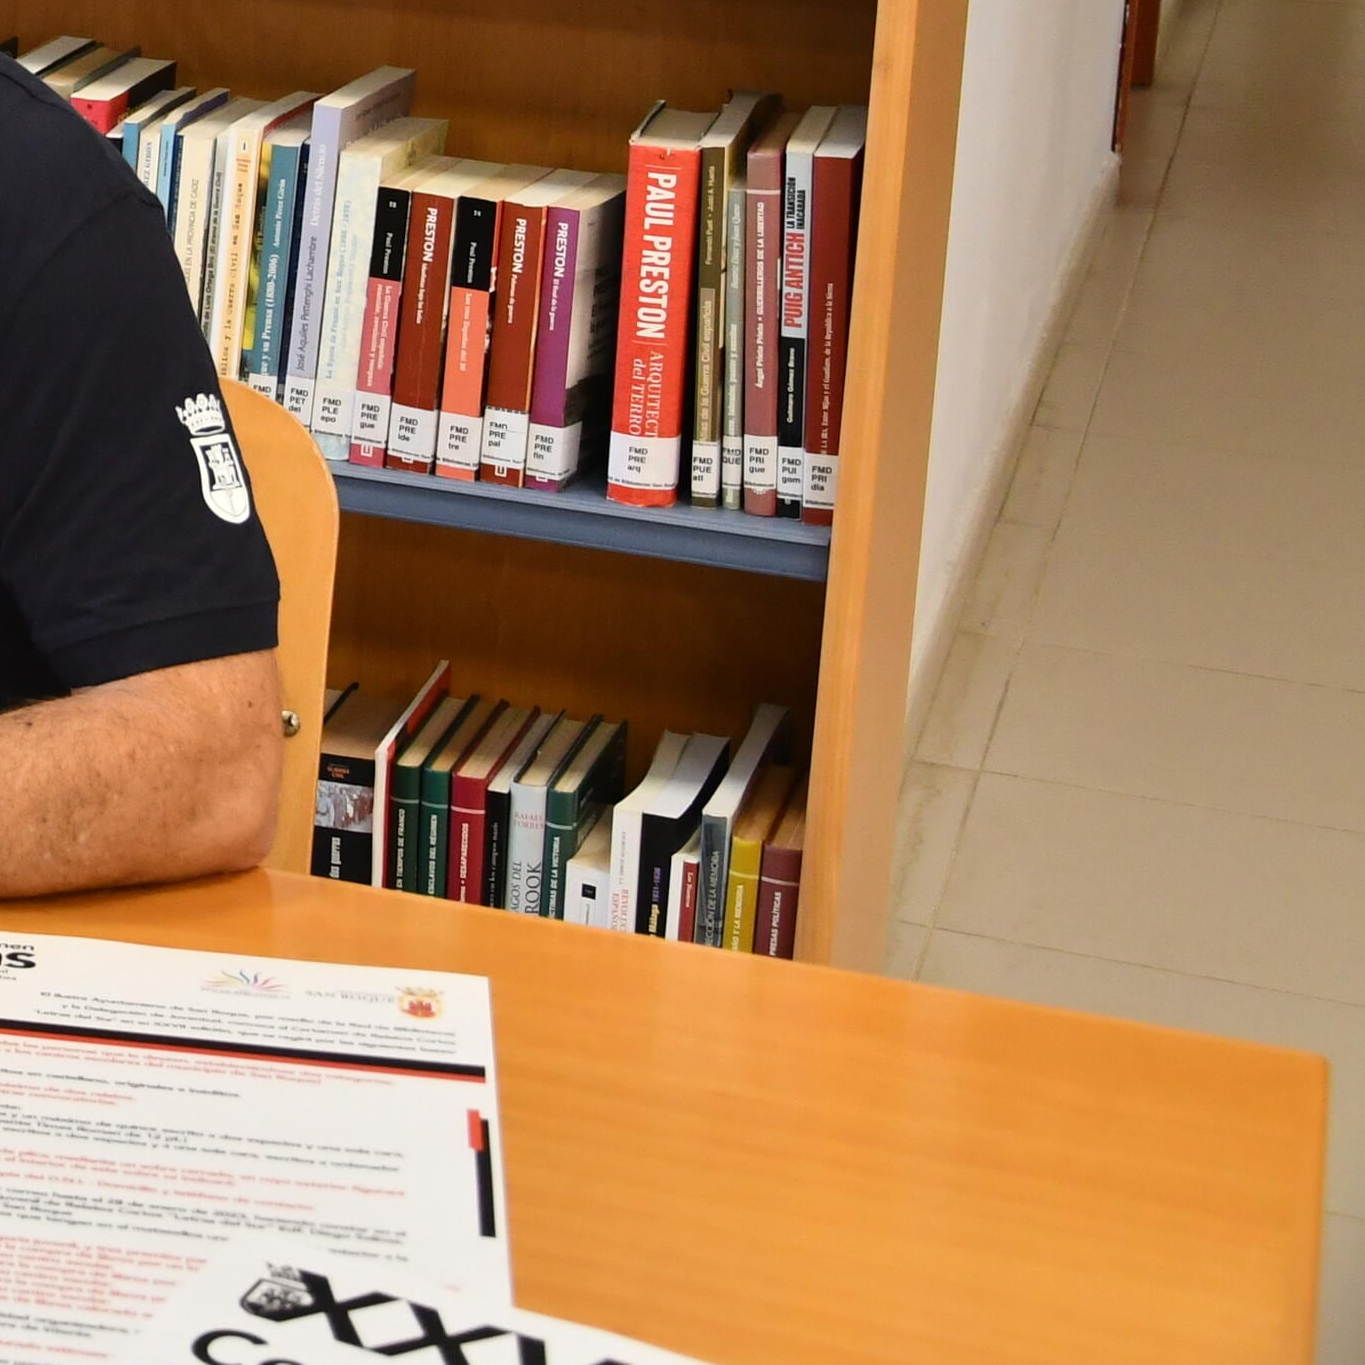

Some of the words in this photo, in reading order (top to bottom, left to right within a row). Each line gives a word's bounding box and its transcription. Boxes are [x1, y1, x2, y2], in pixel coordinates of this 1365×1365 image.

[643, 172, 677, 229] PAUL
[423, 207, 437, 262] PRESTON
[512, 218, 527, 273] PRESTON
[554, 222, 568, 277] PRESTON
[785, 233, 804, 290] ANTICH
[636, 235, 672, 339] PRESTON
[784, 292, 802, 328] PUIG
[632, 358, 646, 379] del
[644, 351, 664, 438] ARQUITECT
[629, 384, 643, 435] TERRO
